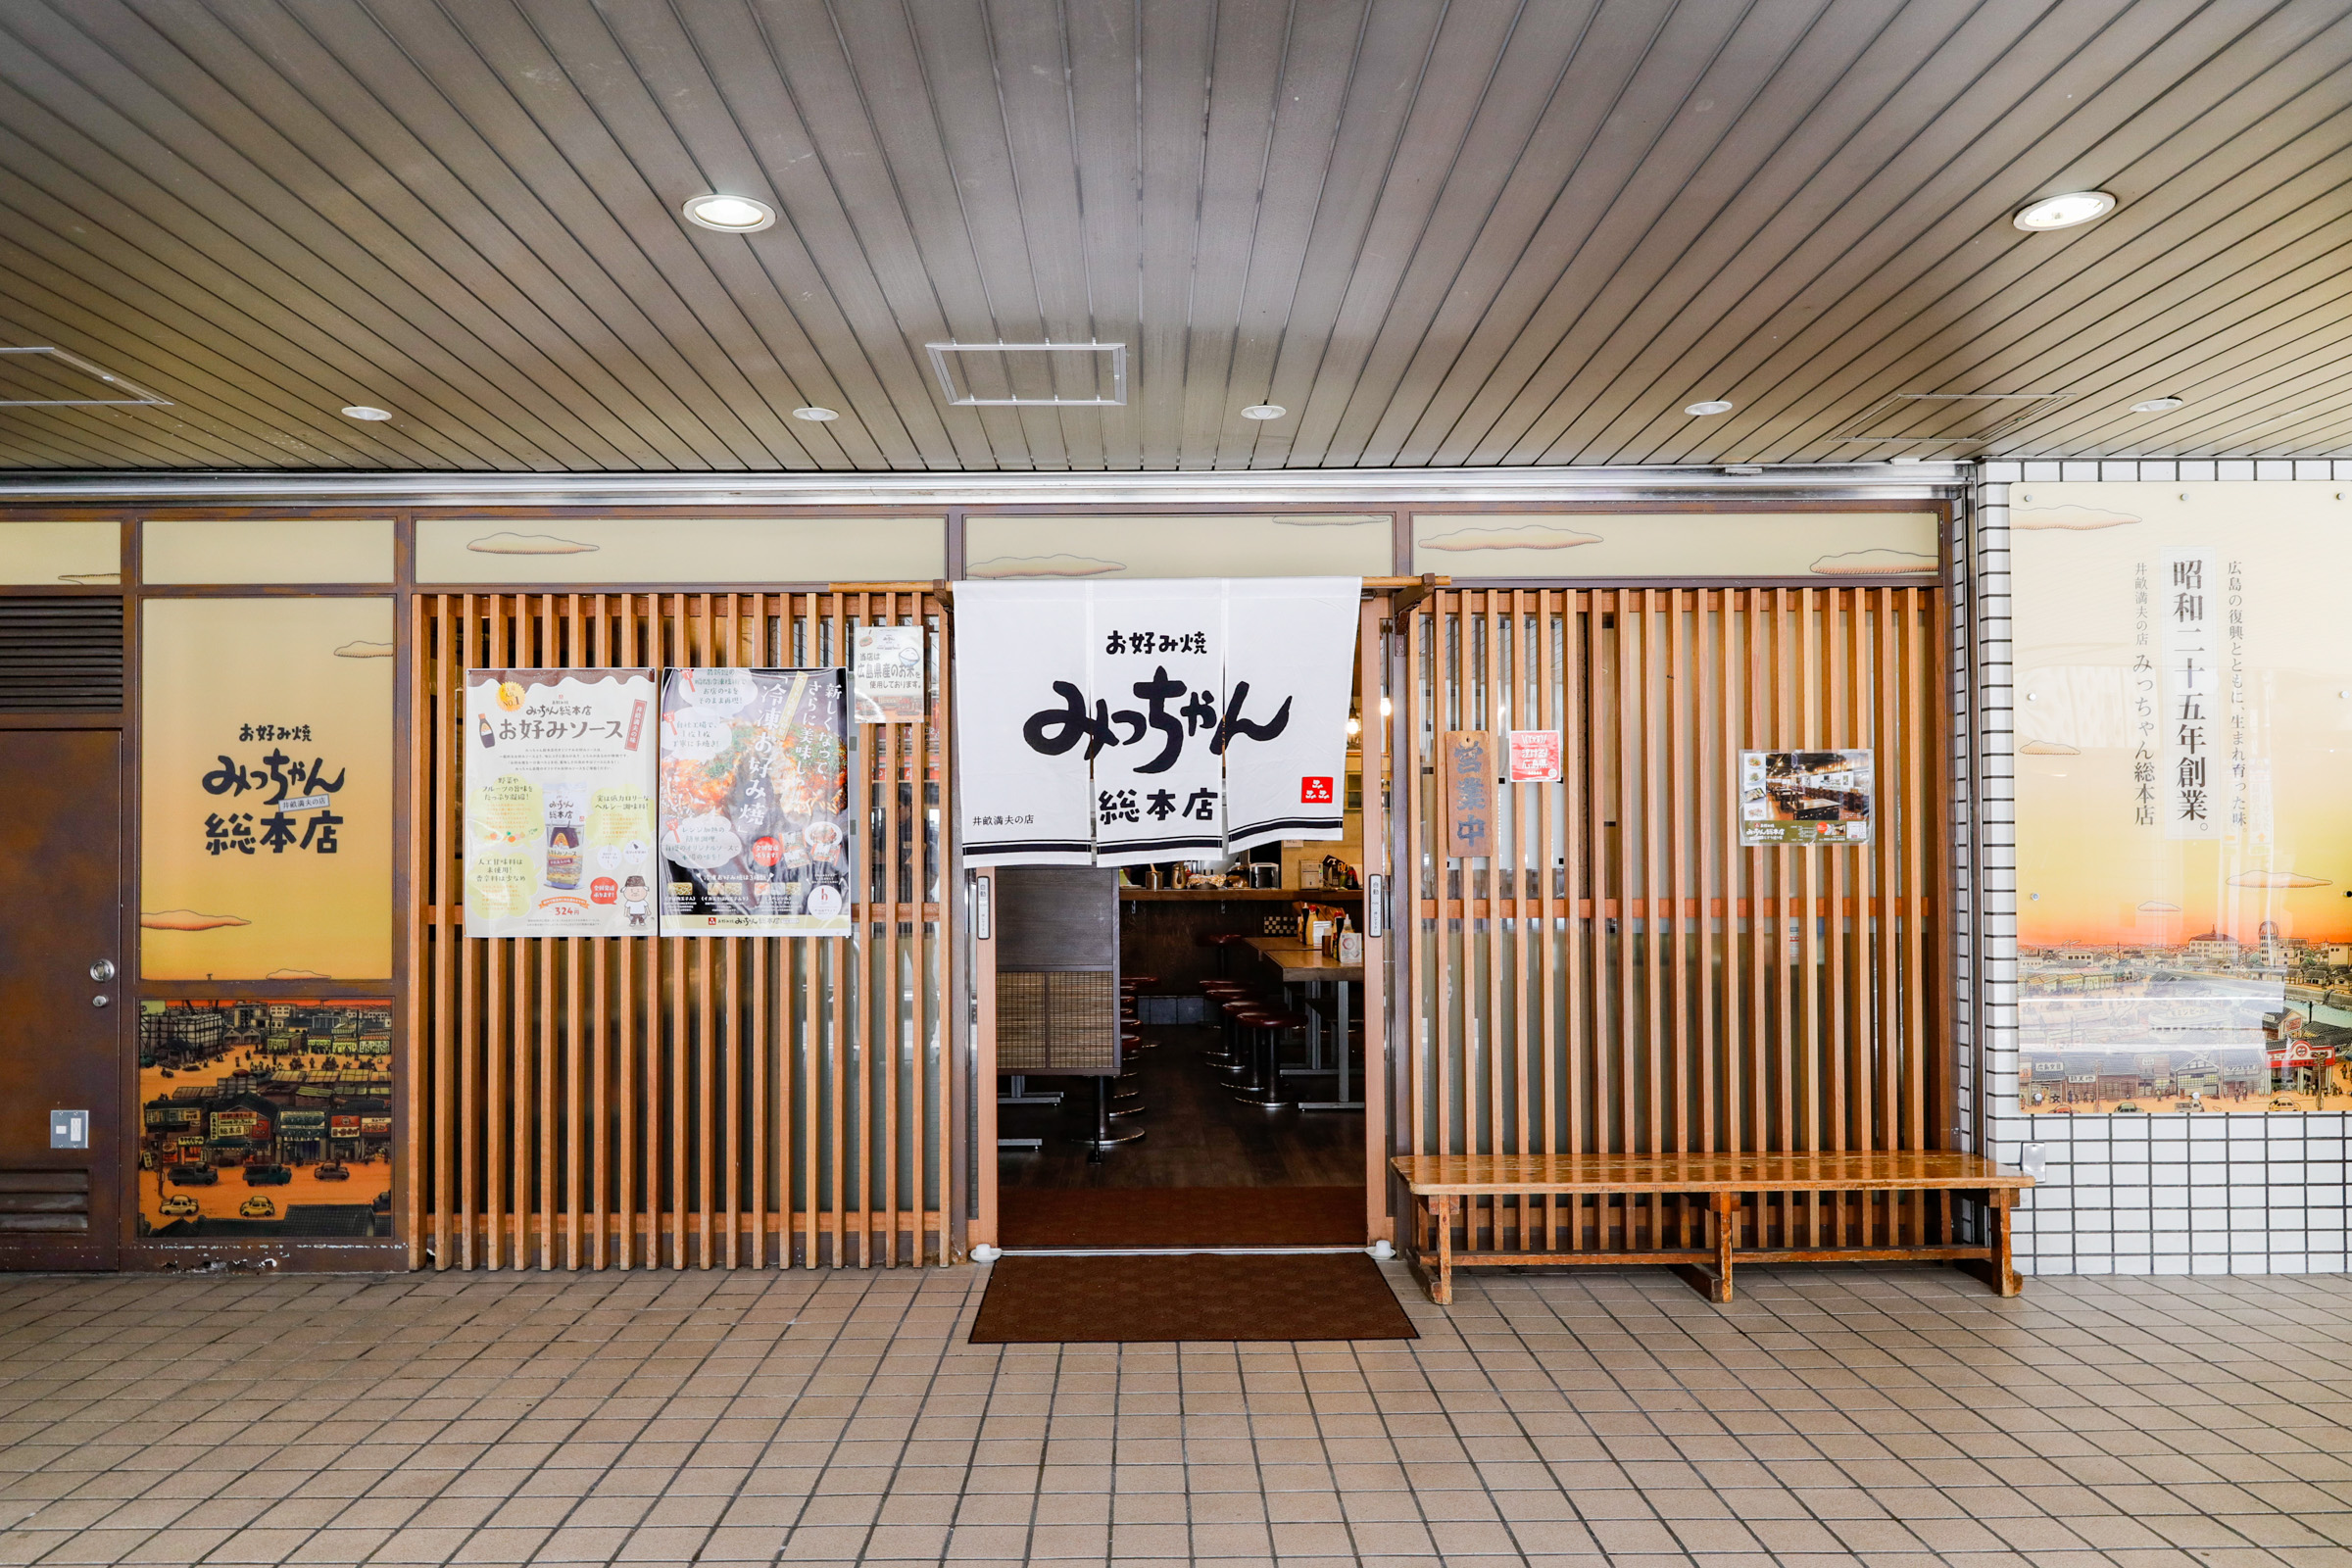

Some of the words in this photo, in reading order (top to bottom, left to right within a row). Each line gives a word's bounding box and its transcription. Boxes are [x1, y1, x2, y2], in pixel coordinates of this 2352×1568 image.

[1105, 630, 1207, 655] お好み焼
[2173, 560, 2208, 831] 昭和二十五年創業。
[239, 723, 312, 742] お好み焼
[499, 718, 623, 740] お好みソース
[1023, 665, 1293, 774] みっちゃん
[2133, 654, 2155, 826] みっちゃん総本店
[202, 748, 345, 805] みっちゃん
[1454, 741, 1486, 847] 営業中
[972, 814, 1035, 827] 井畝満夫の店
[1099, 787, 1218, 825] 総本店
[204, 810, 343, 856] 総本店
